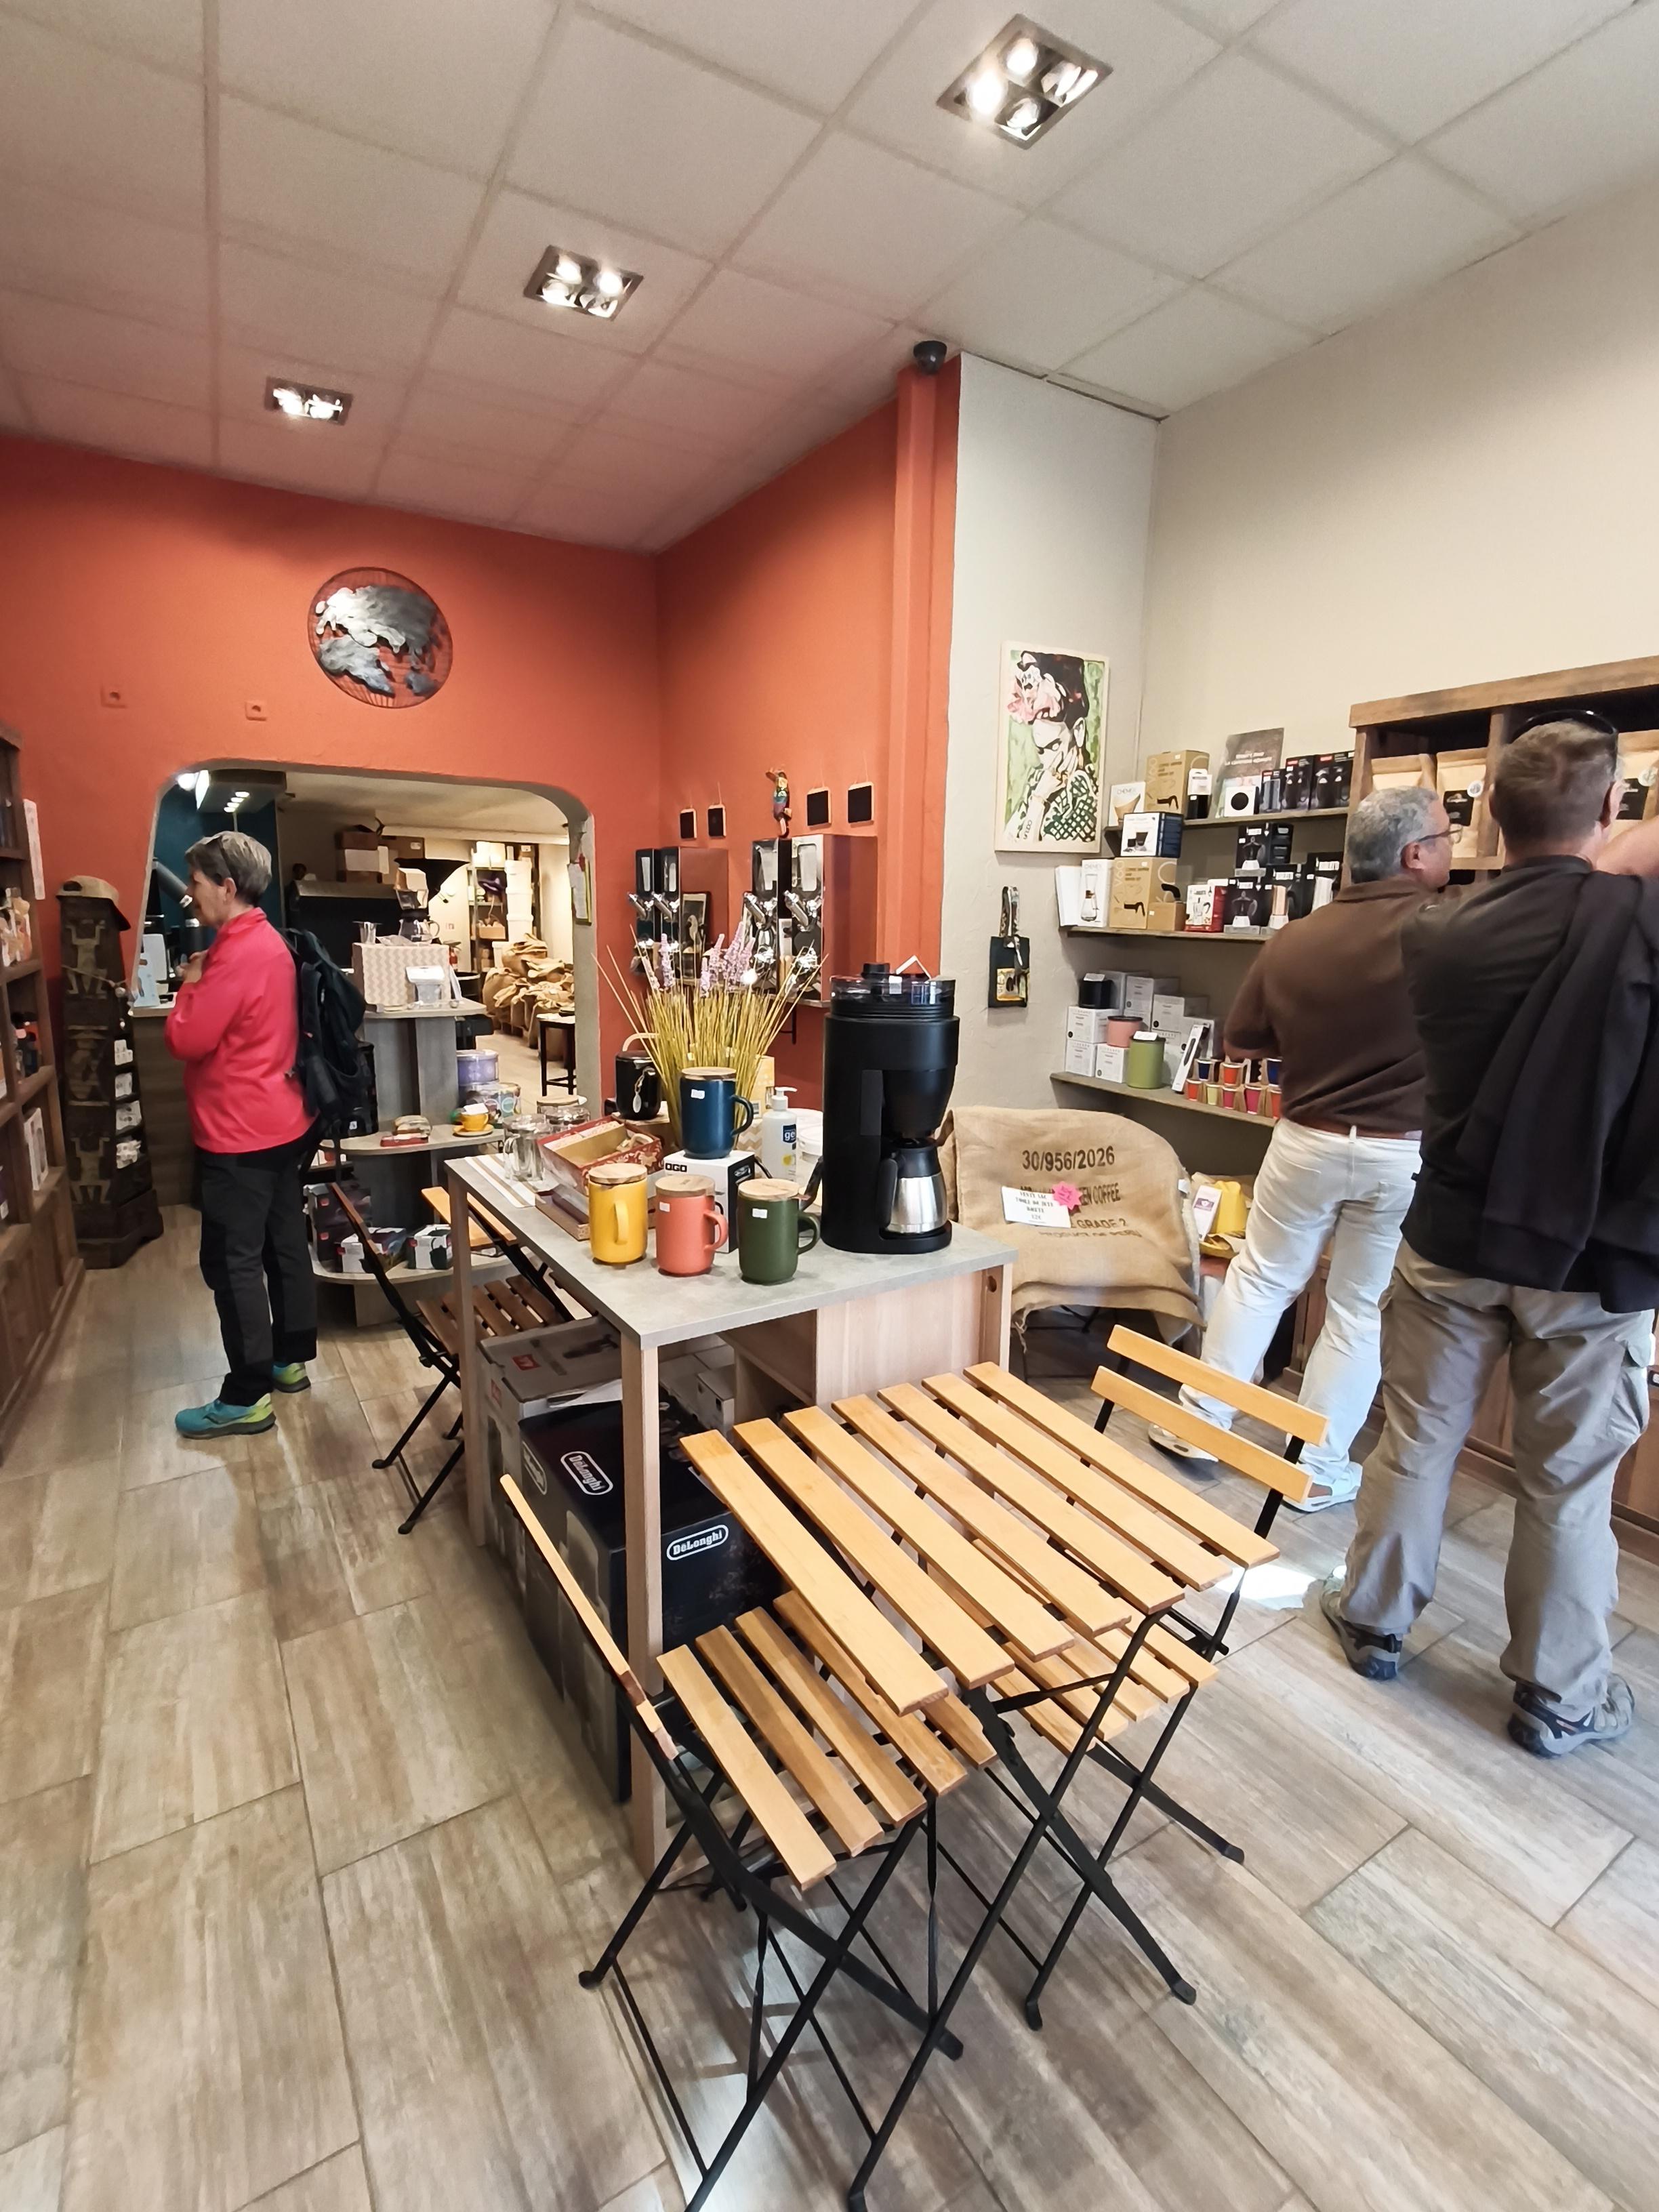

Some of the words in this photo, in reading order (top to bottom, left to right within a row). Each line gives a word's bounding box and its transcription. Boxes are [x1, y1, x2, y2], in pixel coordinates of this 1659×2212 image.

[1022, 1145, 1115, 1172] 30/956/2026
[665, 1162, 687, 1173] OGO
[1092, 1182, 1121, 1205] COFFEE
[1077, 1218, 1118, 1229] GRADE
[1120, 1218, 1127, 1227] 2
